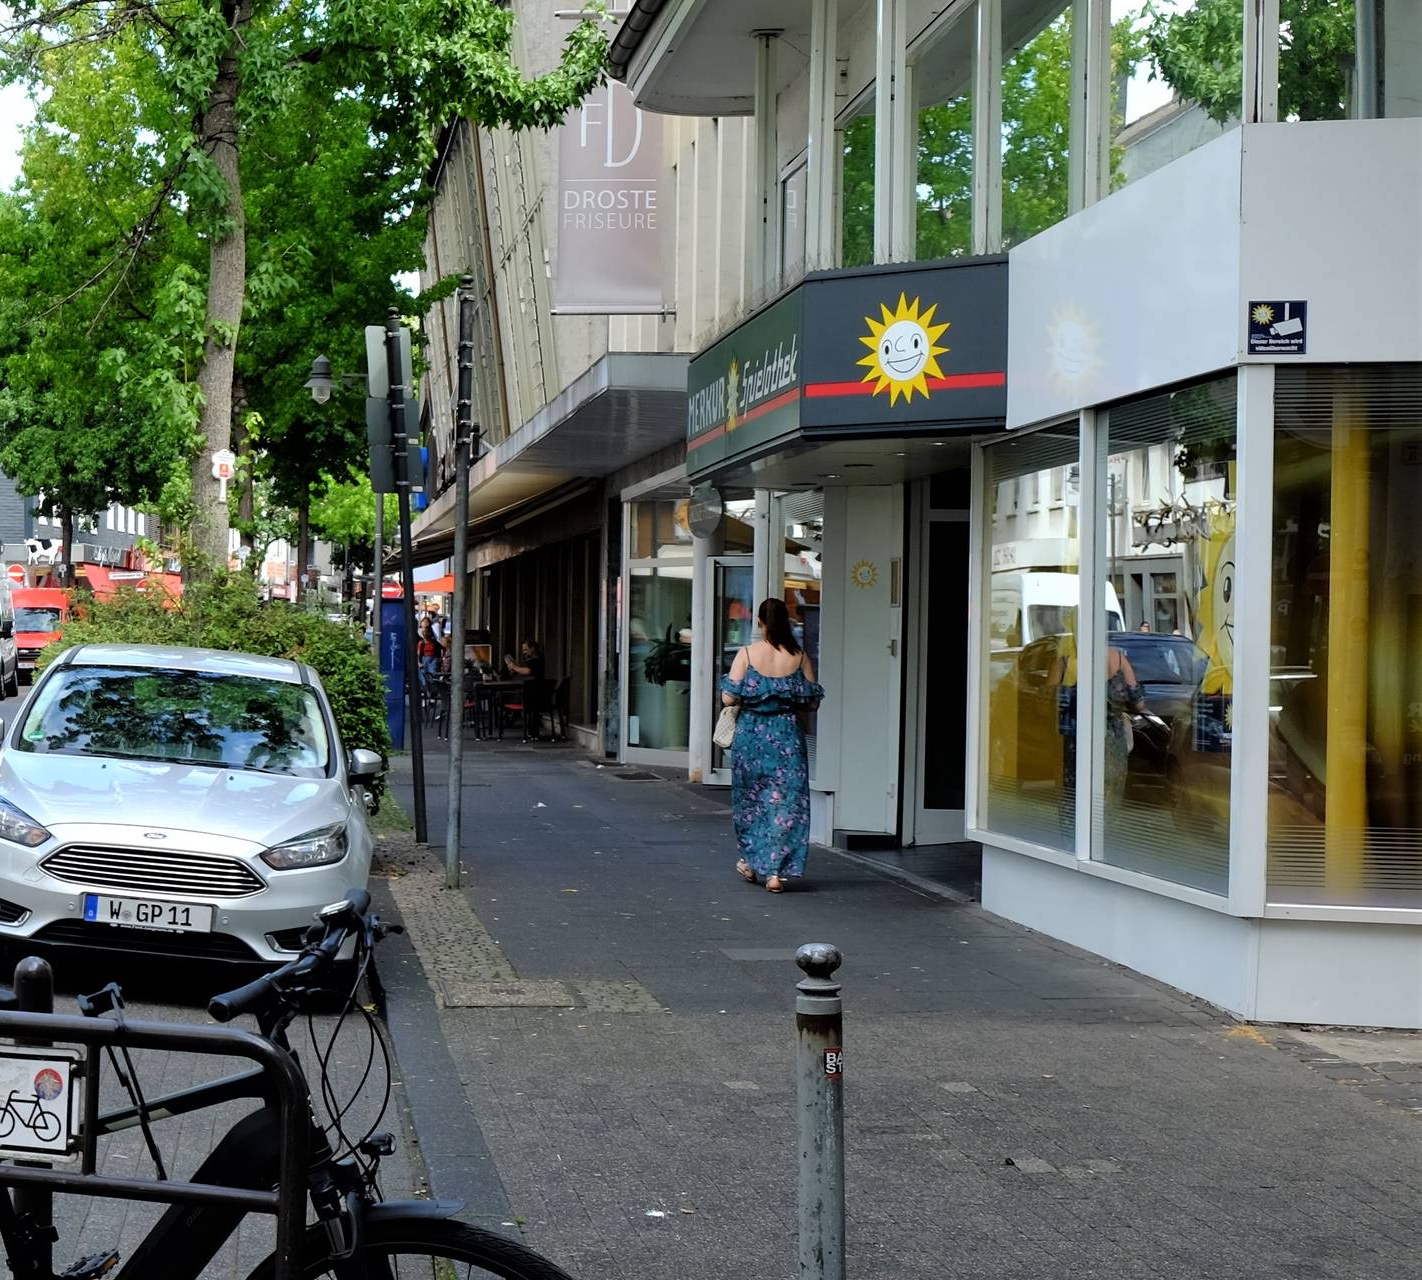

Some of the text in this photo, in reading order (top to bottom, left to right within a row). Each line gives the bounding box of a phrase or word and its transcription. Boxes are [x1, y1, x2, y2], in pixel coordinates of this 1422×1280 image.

[564, 190, 658, 209] DROSTE
[563, 212, 657, 230] FRISEURE
[688, 333, 797, 437] MERKUR Spielothek
[110, 900, 192, 926] W GP 11
